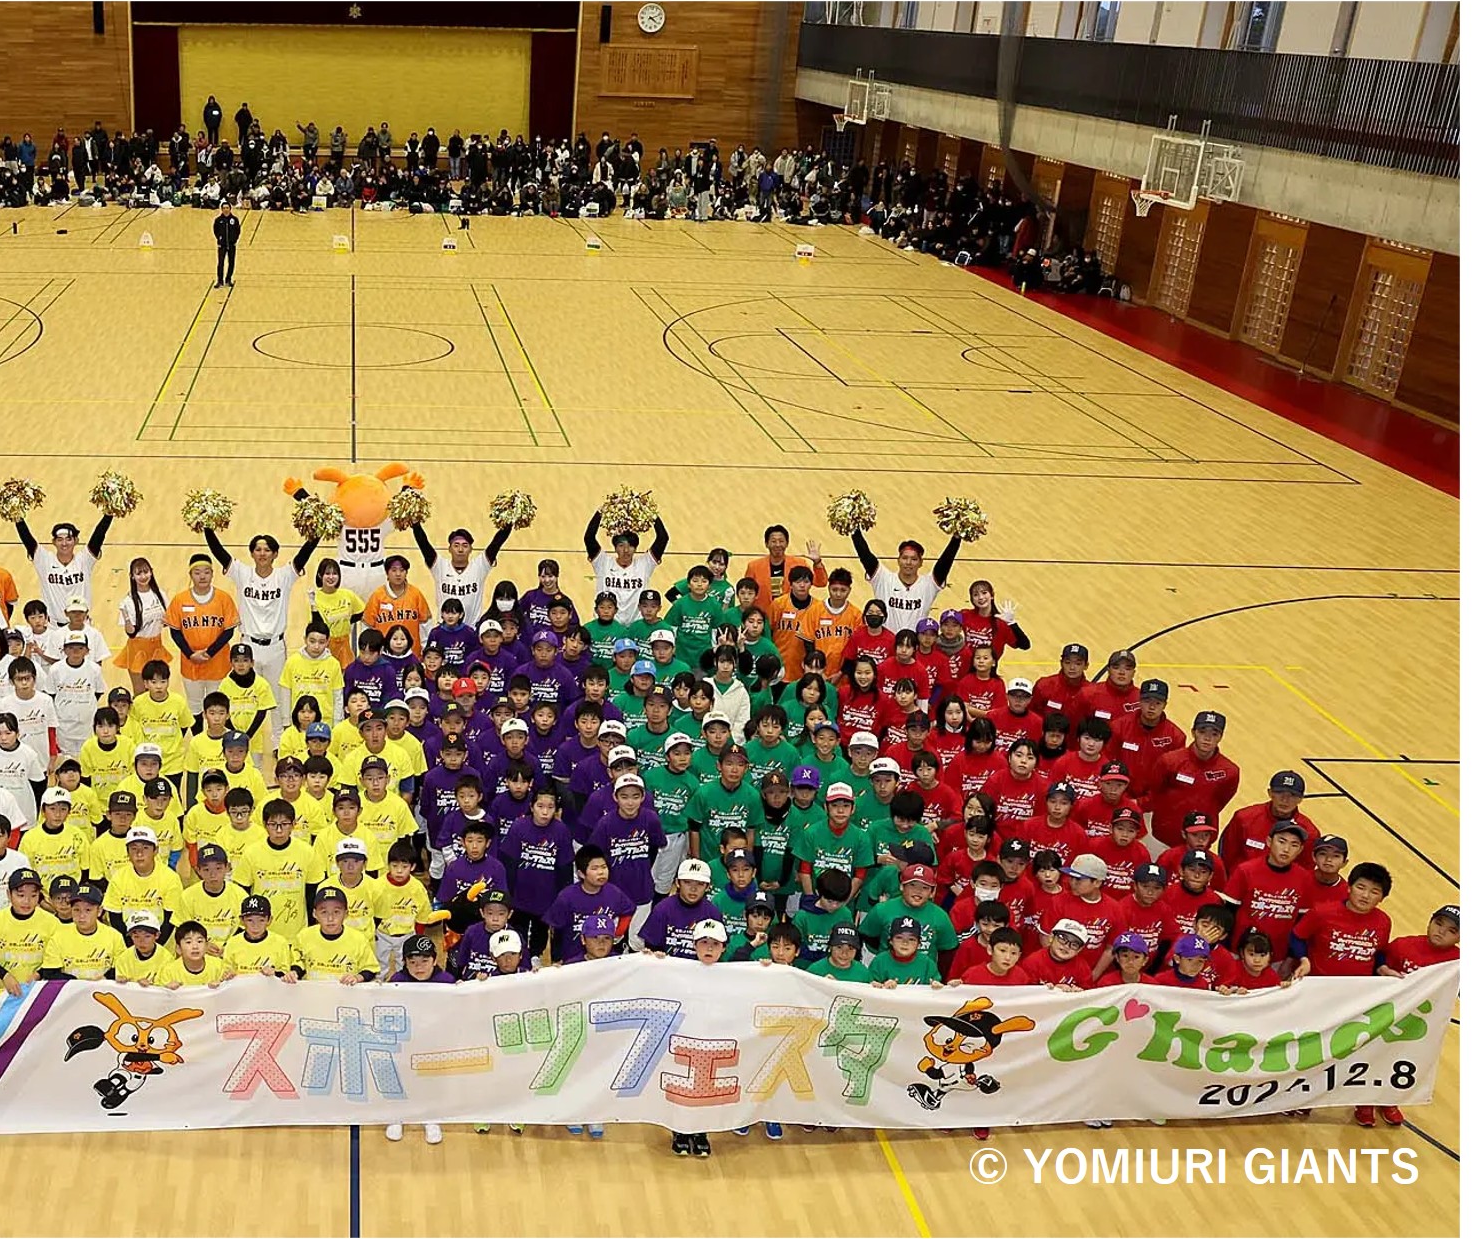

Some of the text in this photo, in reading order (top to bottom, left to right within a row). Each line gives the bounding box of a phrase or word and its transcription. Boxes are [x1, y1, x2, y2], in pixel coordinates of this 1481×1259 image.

[344, 528, 381, 554] 555
[47, 571, 85, 585] GIANTS
[604, 576, 644, 590] GIANTS
[243, 586, 282, 600] GIANTS
[441, 582, 478, 596] GIANTS
[182, 614, 226, 629] GIANTS
[215, 994, 903, 1106] スポーツフェスタ
